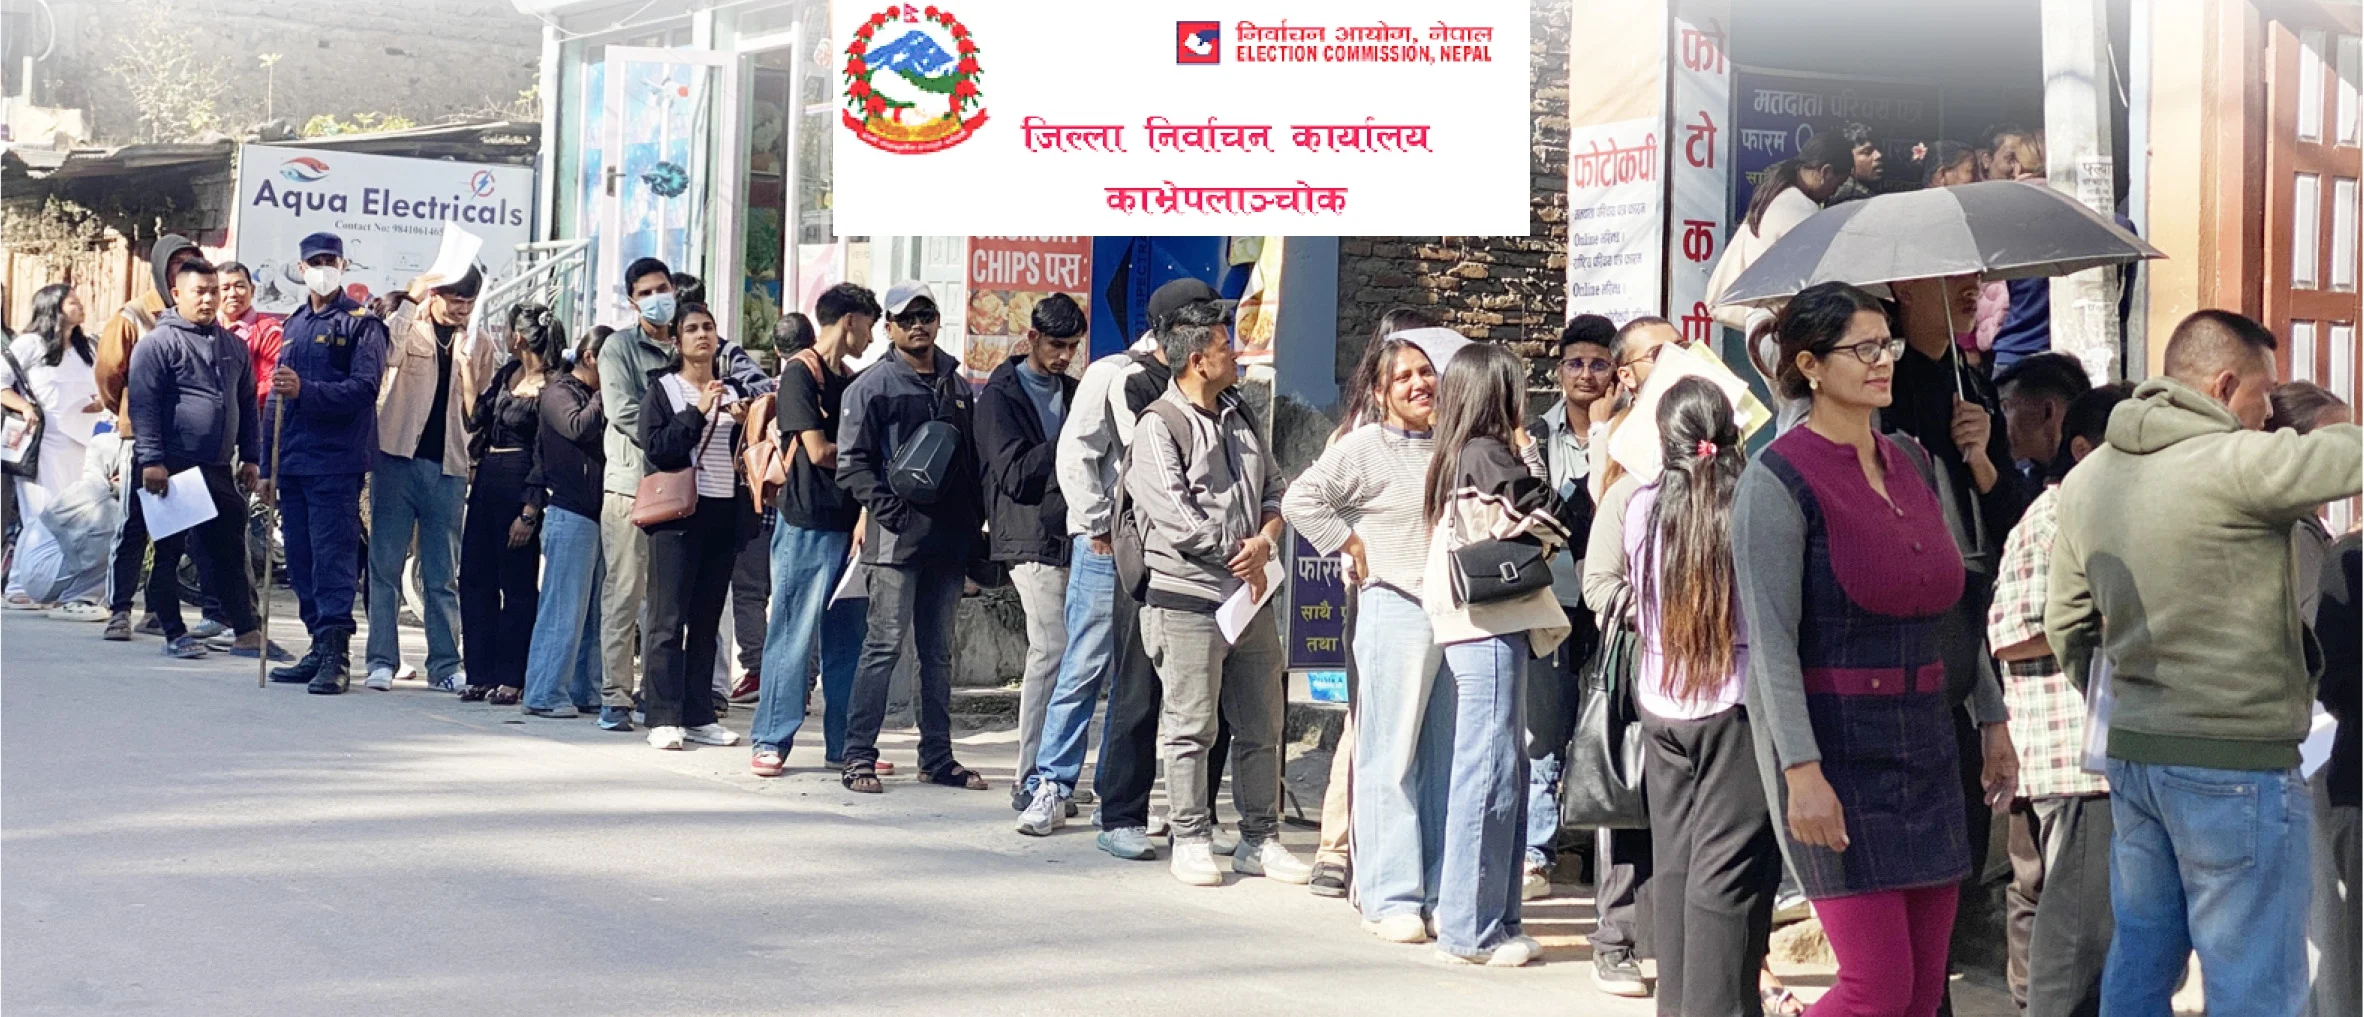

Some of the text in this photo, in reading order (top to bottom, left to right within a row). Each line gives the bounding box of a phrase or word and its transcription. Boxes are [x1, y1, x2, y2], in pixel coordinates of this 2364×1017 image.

[1753, 88, 1823, 117] मतदाता
[1741, 128, 1787, 157] फारम
[1573, 132, 1658, 189] फोटोकपी
[252, 178, 523, 227] Aqua Electricals
[335, 220, 372, 231] Contact
[374, 222, 390, 232] No:
[1574, 233, 1599, 247] Online
[972, 248, 1040, 285] CHIPS
[1573, 282, 1600, 298] Online
[1301, 601, 1332, 622] साथै
[1306, 637, 1339, 653] तथा
